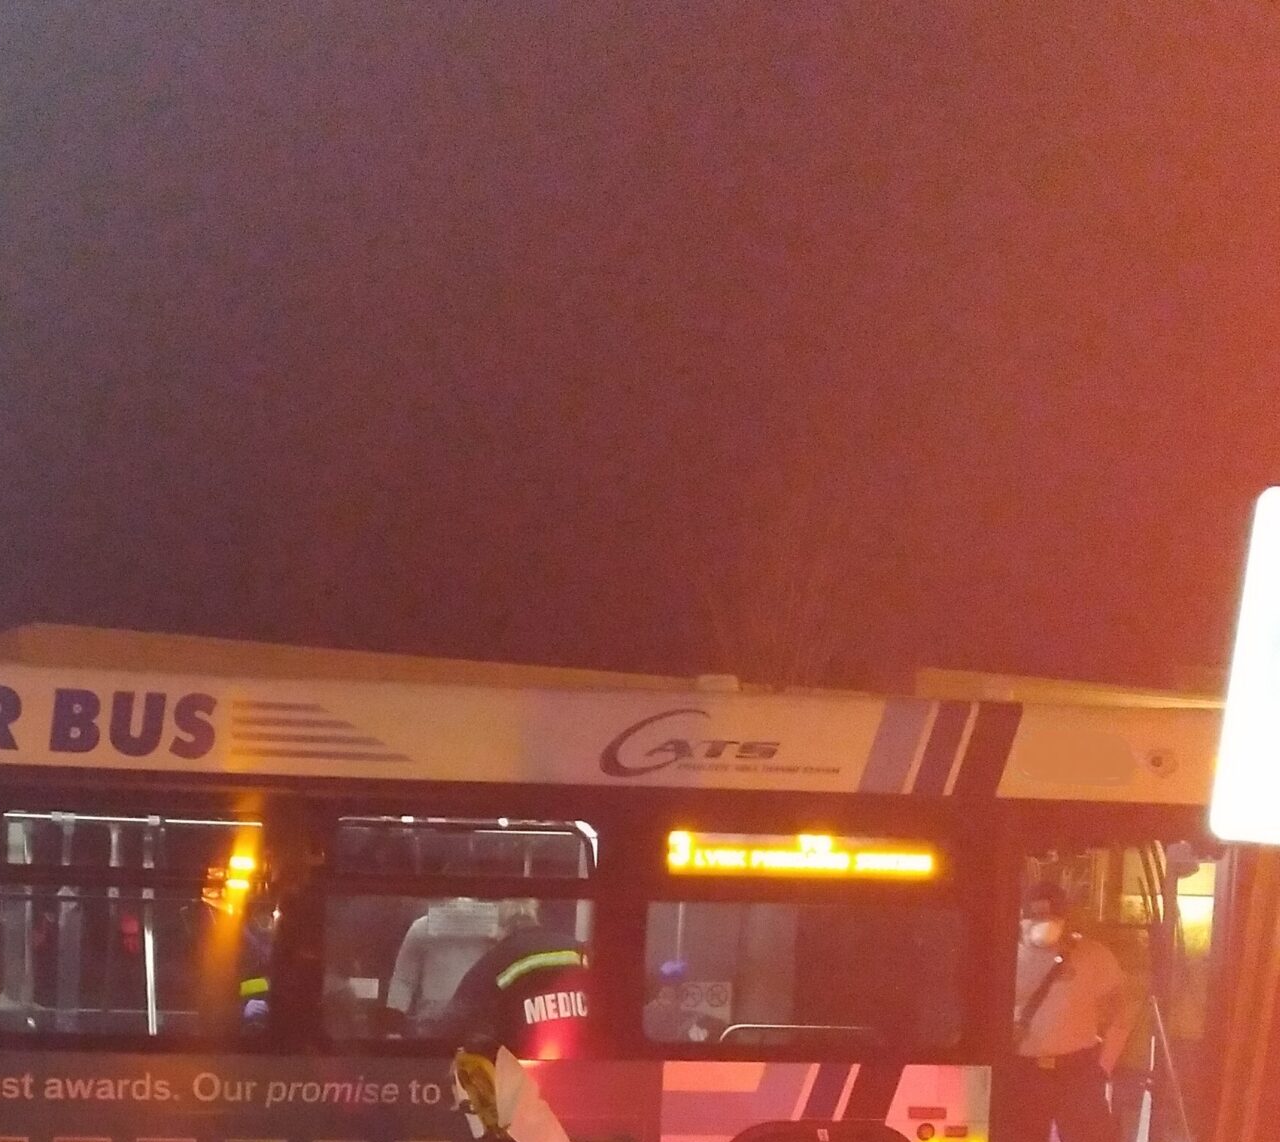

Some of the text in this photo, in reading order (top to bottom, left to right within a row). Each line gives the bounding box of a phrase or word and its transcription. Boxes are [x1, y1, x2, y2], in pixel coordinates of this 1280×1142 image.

[49, 687, 218, 759] BUS
[599, 709, 780, 777] CATS
[524, 991, 587, 1024] MEDIC
[43, 1072, 180, 1101] awards.
[192, 1072, 257, 1101] Our
[265, 1075, 399, 1108] promise
[408, 1078, 441, 1104] to
